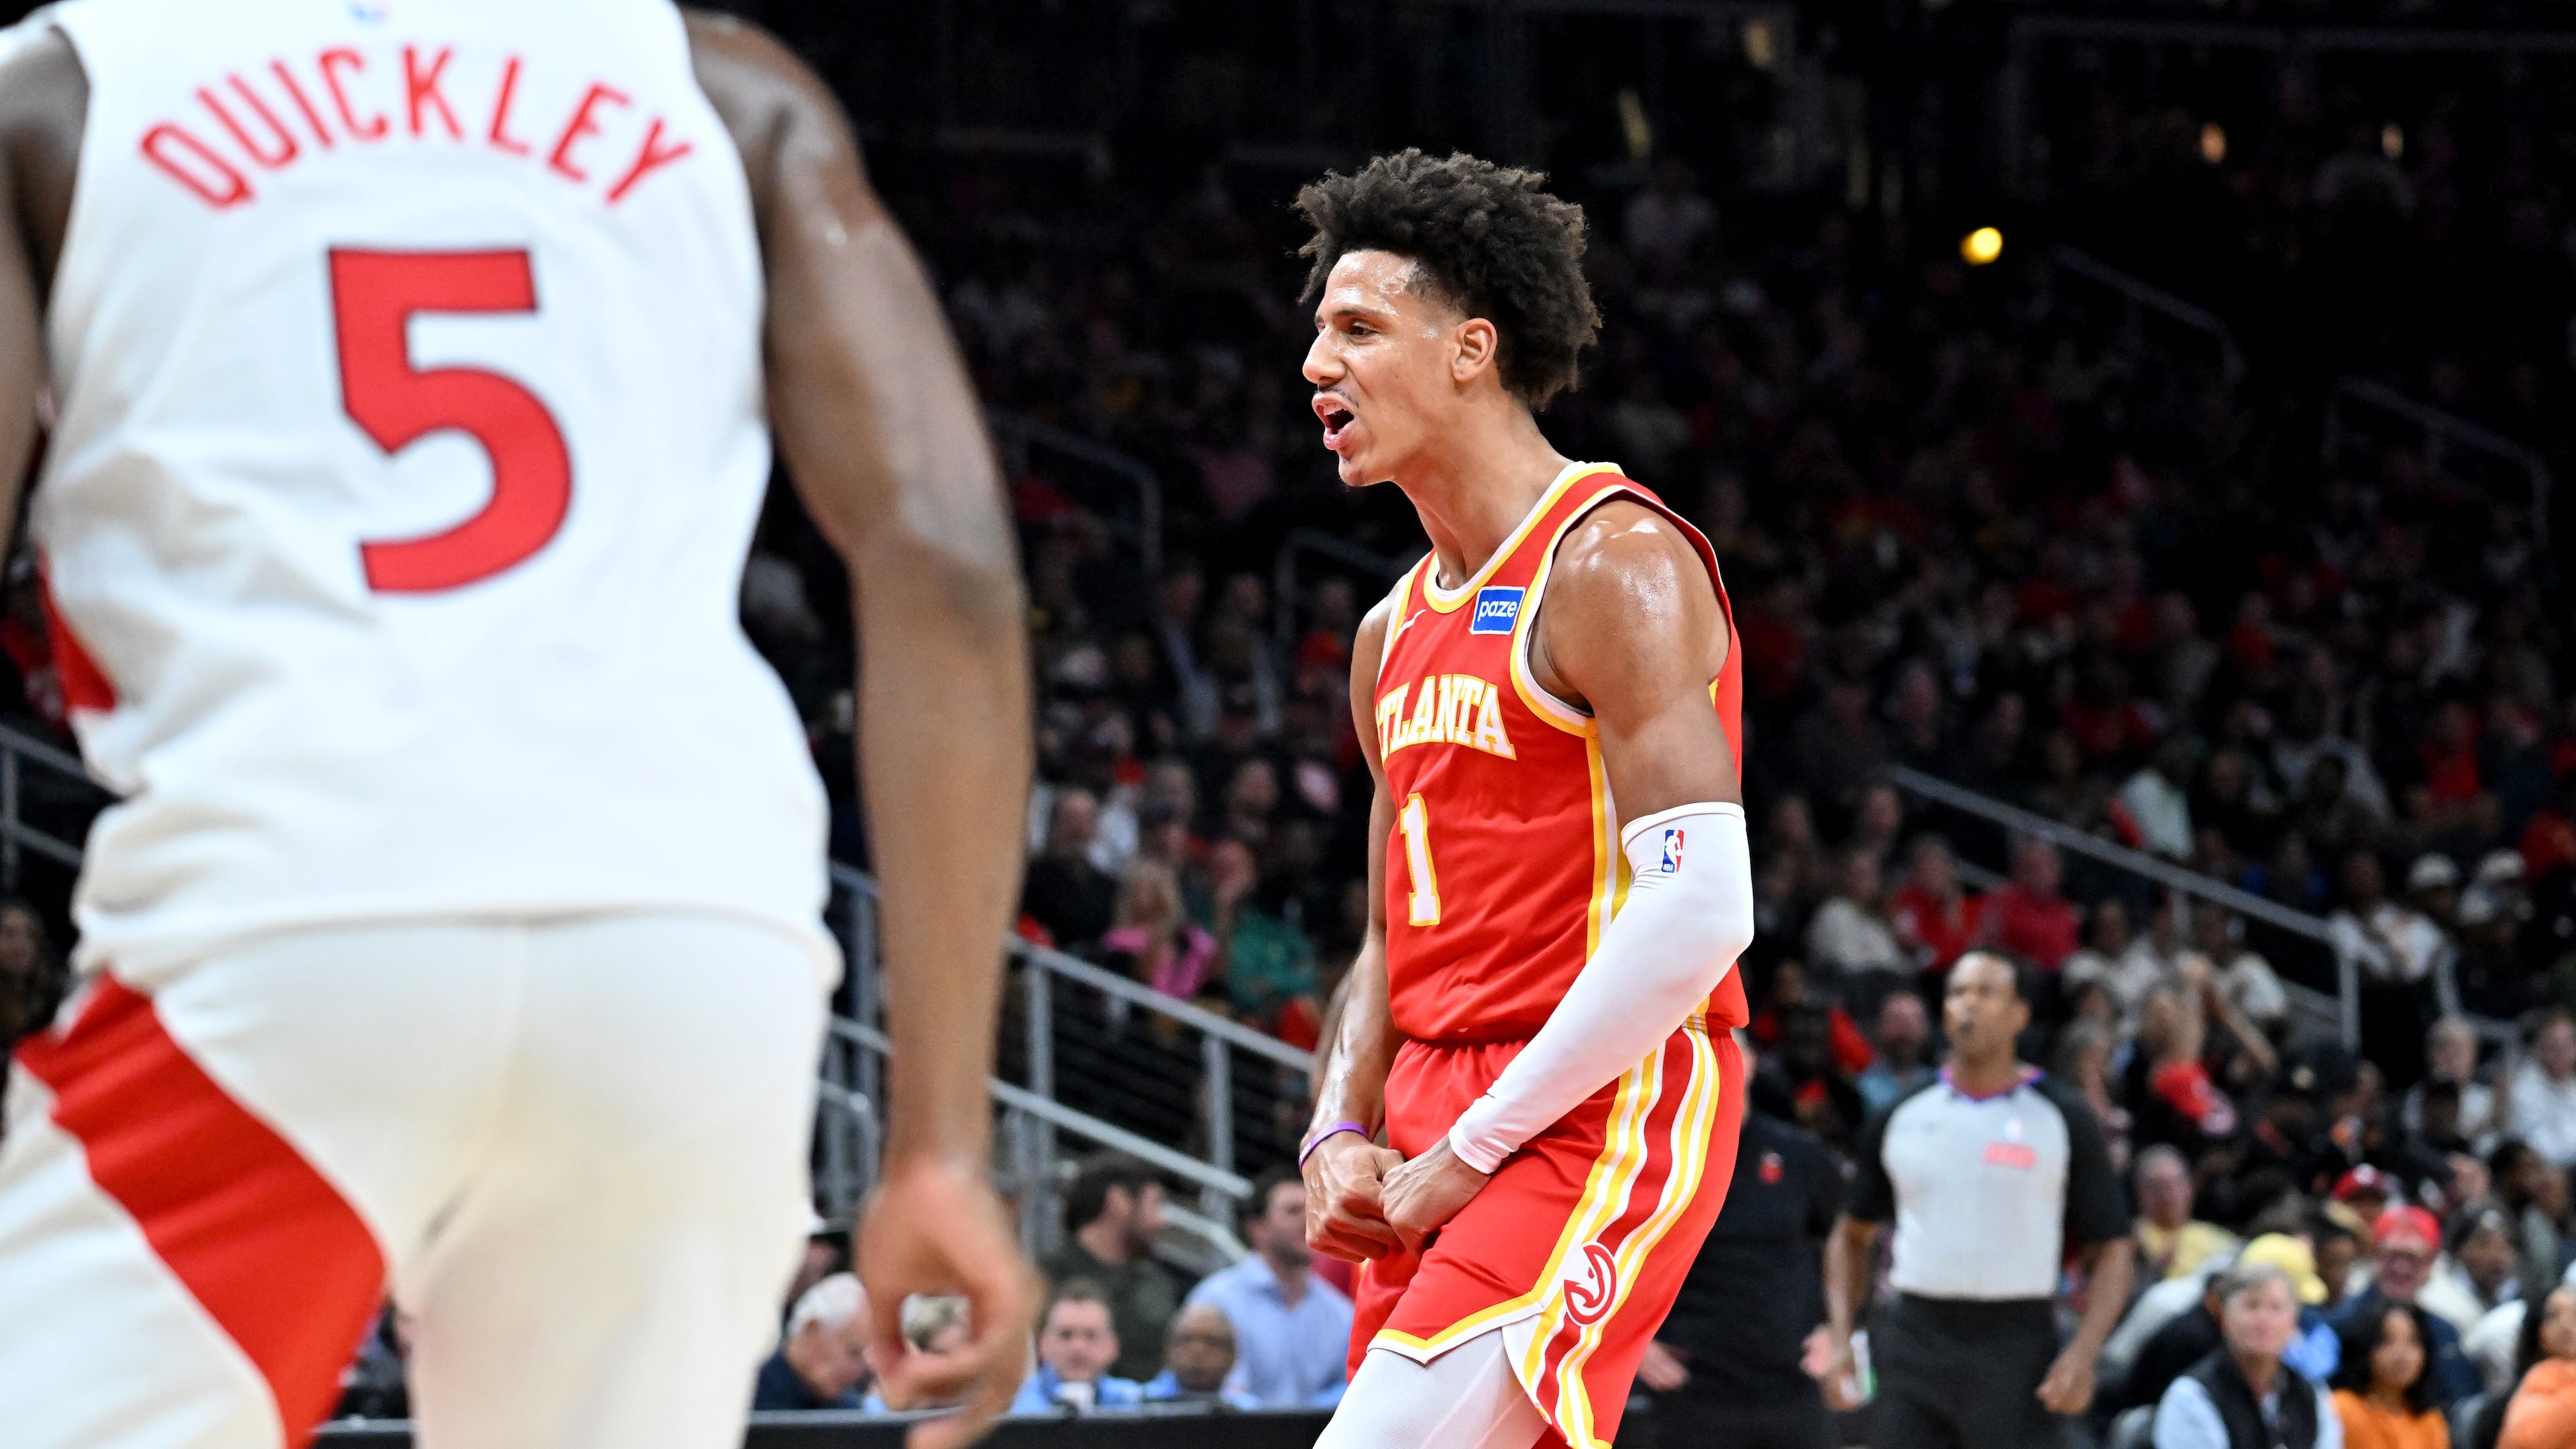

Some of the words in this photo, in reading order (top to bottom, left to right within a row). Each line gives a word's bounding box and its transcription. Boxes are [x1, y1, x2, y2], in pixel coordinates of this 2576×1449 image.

[140, 45, 692, 210] QUICKLEY
[327, 247, 574, 595] 5
[1477, 600, 1517, 623] paze
[1375, 674, 1517, 765] TLANTA
[1400, 792, 1441, 927] 1
[1663, 863, 1674, 871] NBA
